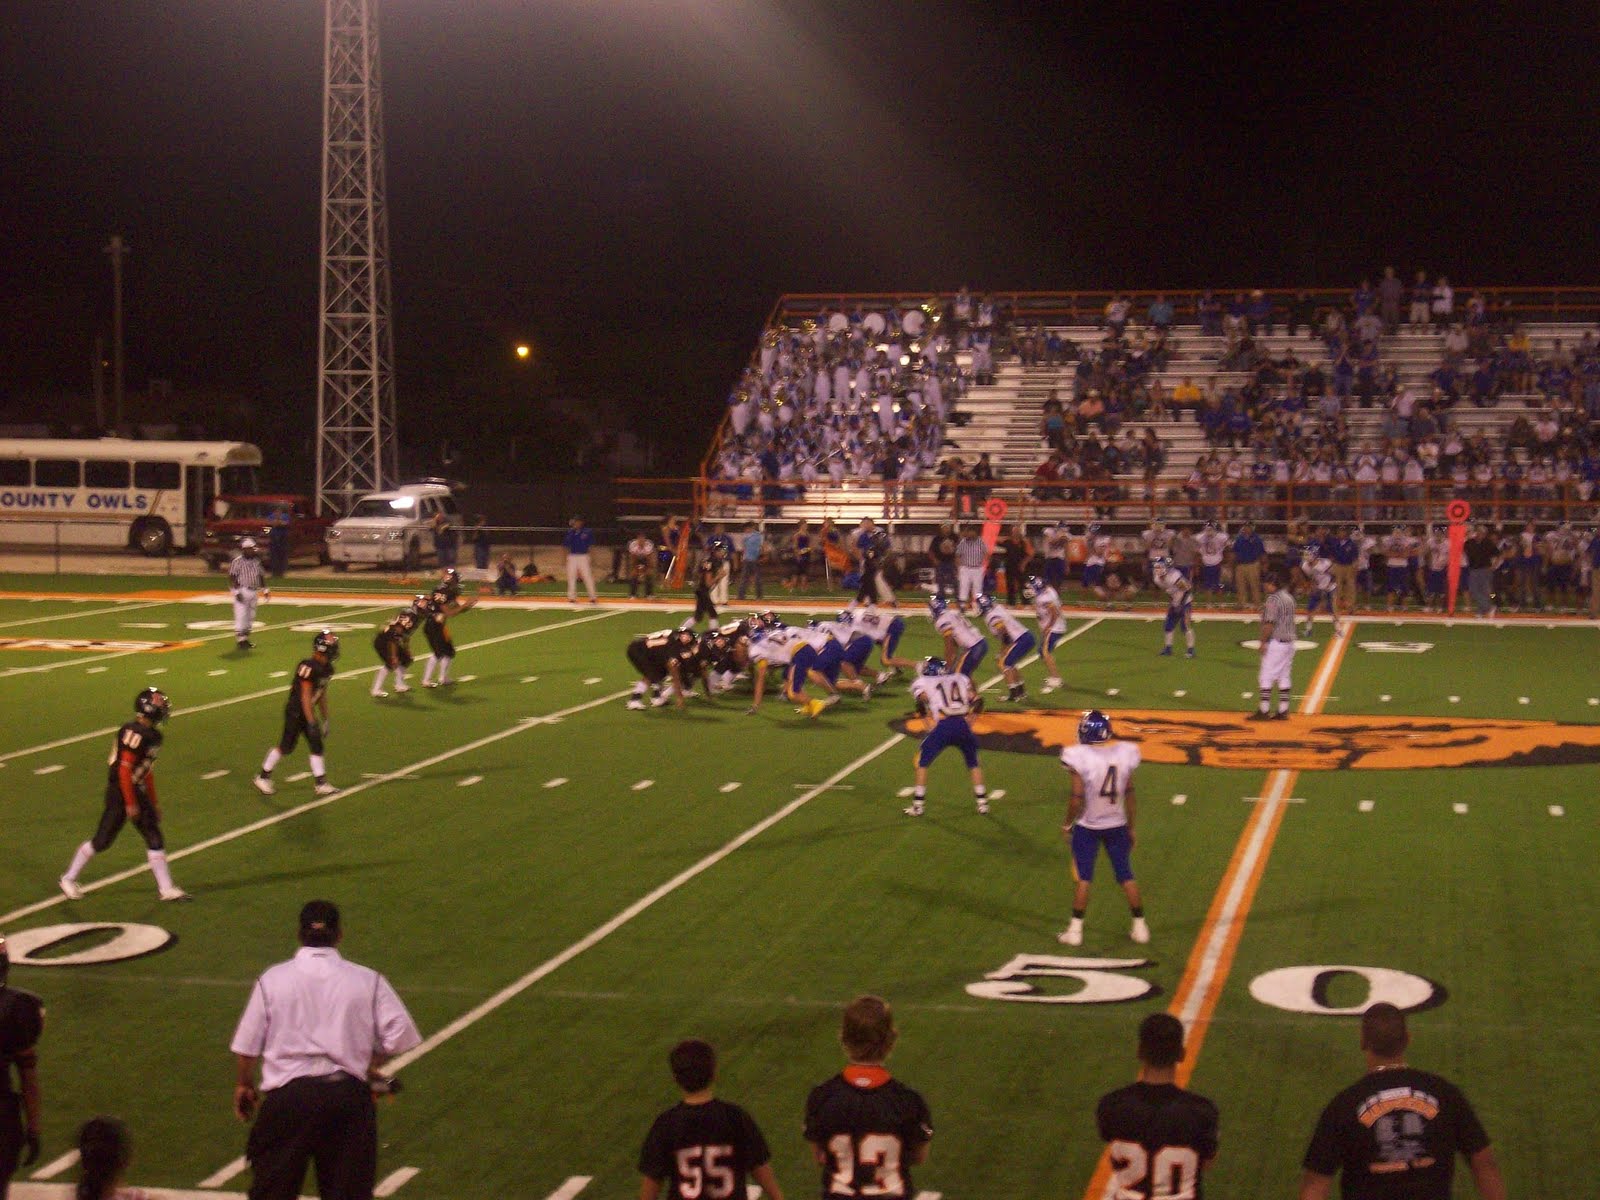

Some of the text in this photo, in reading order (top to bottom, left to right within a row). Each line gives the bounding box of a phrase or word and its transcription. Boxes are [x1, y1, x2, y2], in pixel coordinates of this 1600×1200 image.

[1, 492, 147, 509] OUNTY OWLS
[935, 680, 963, 707] 14
[1100, 765, 1118, 804] 4
[675, 1144, 735, 1199] 55
[827, 1133, 904, 1197] 13
[1110, 1139, 1199, 1200] 20
